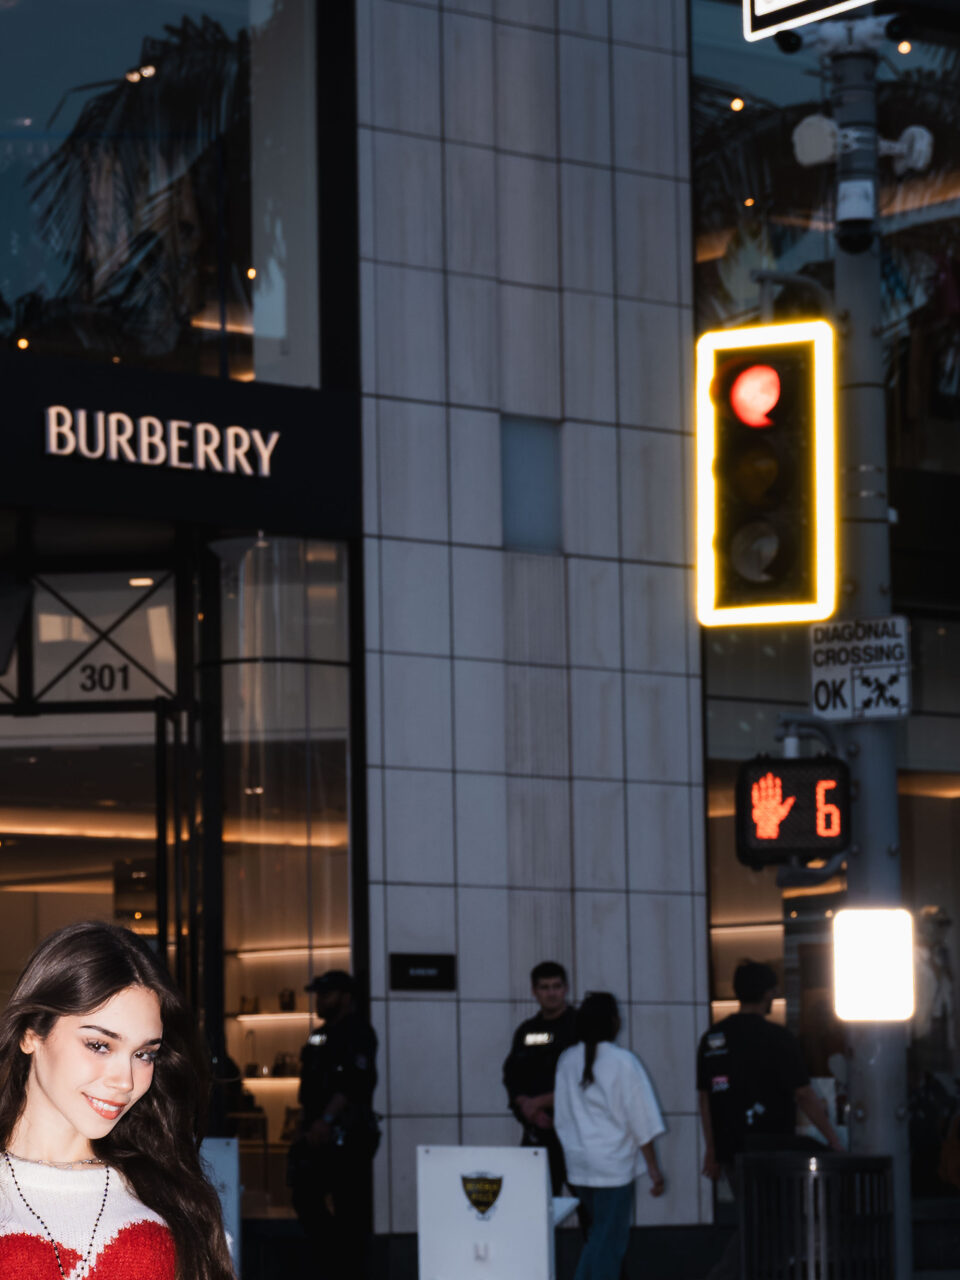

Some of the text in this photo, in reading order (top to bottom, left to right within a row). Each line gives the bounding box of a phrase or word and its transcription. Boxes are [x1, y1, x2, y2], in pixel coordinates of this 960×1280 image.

[45, 405, 280, 477] BURBERRY
[813, 621, 901, 645] DIAGONAL
[813, 643, 905, 667] CROSSING
[79, 664, 131, 692] 301
[814, 679, 847, 711] OK
[816, 779, 841, 837] 6
